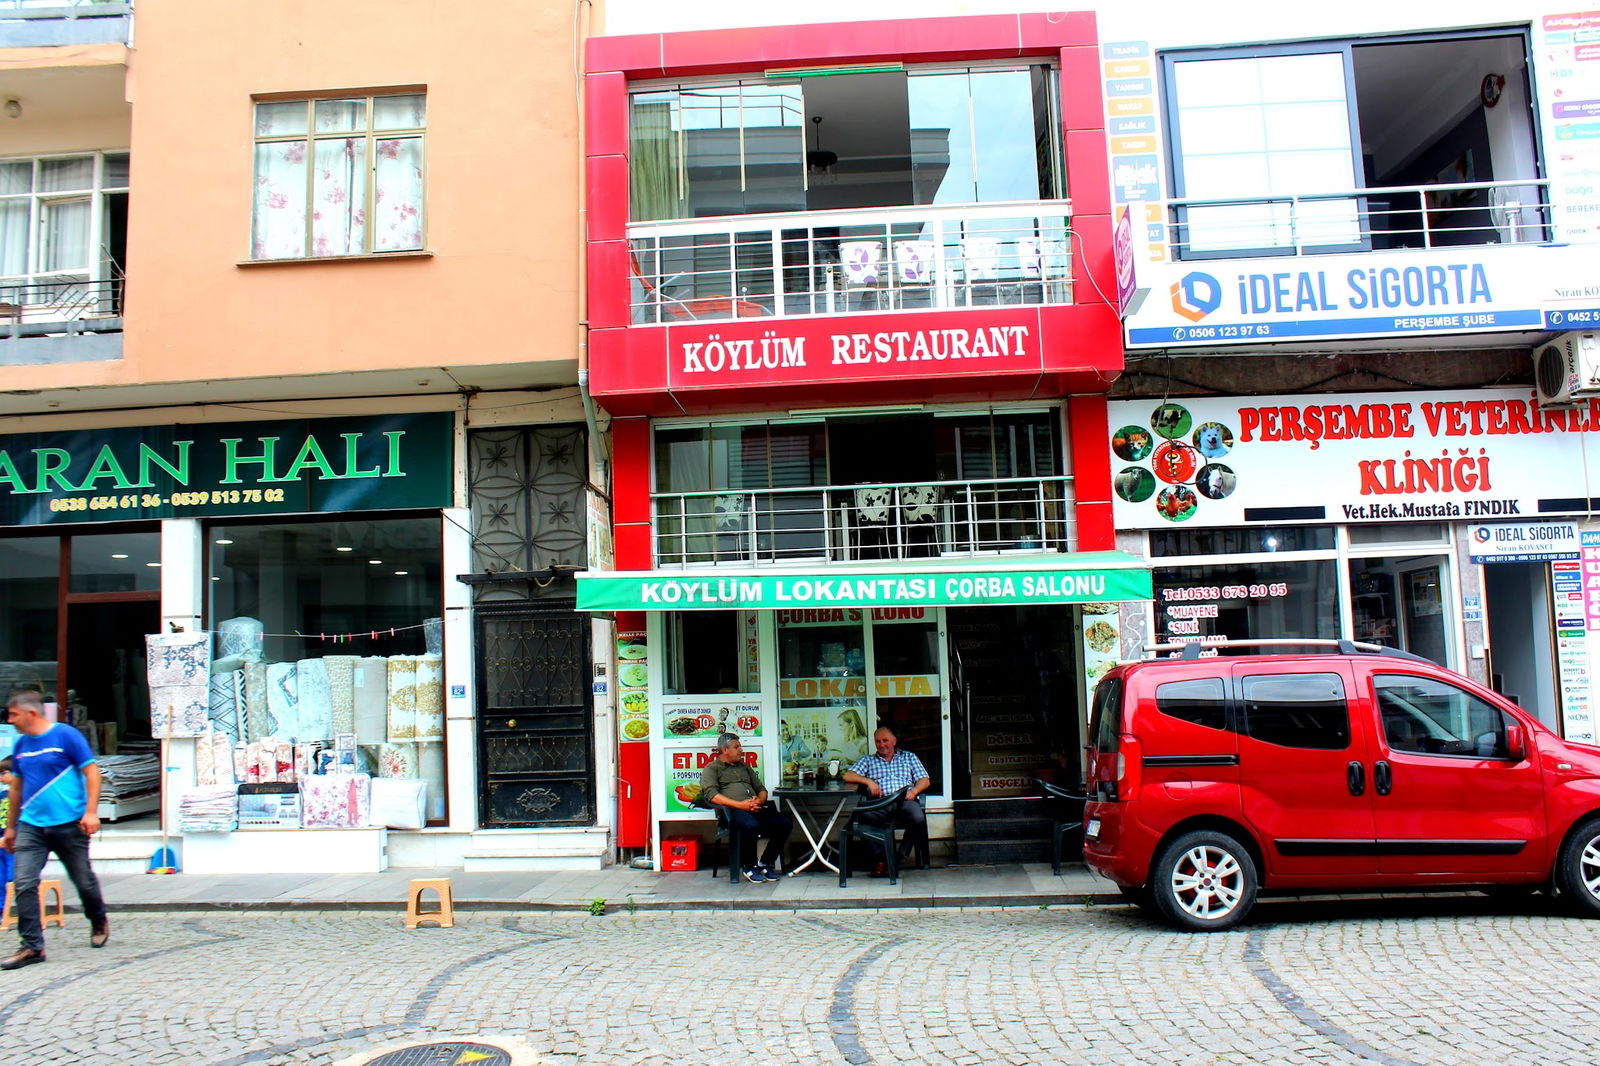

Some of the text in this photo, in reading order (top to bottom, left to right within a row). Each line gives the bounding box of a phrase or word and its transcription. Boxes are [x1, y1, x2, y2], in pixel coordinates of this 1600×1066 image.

[1394, 313, 1496, 330] PERŞEMBE ŞUBE
[1567, 312, 1590, 323] 0452
[1188, 324, 1270, 338] 0506 123 97 63
[683, 325, 1029, 373] KÖYLÜM RESTAURANT
[1238, 402, 1416, 450] PERŞEMBE
[219, 430, 406, 484] HALI
[1358, 447, 1492, 495] KLİNİĞİ
[50, 498, 87, 512] 0538
[89, 496, 118, 510] 654
[120, 495, 138, 508] 61
[141, 493, 161, 507] 36
[171, 491, 209, 507] 0539
[211, 490, 240, 504] 513
[243, 489, 262, 503] 75
[264, 488, 284, 502] 02
[1342, 499, 1521, 520] Vet.Hek.Mustafa FINDIK
[641, 575, 1105, 603] KÖYLÜM LOKANTASI ÇORBA SALONU
[1163, 582, 1287, 601] Tel:0533 678 20 95
[777, 608, 840, 627] ÇORBA
[780, 676, 932, 699] LOKANTA
[988, 732, 1031, 745] DÖNER
[673, 748, 758, 769] ET DÖER
